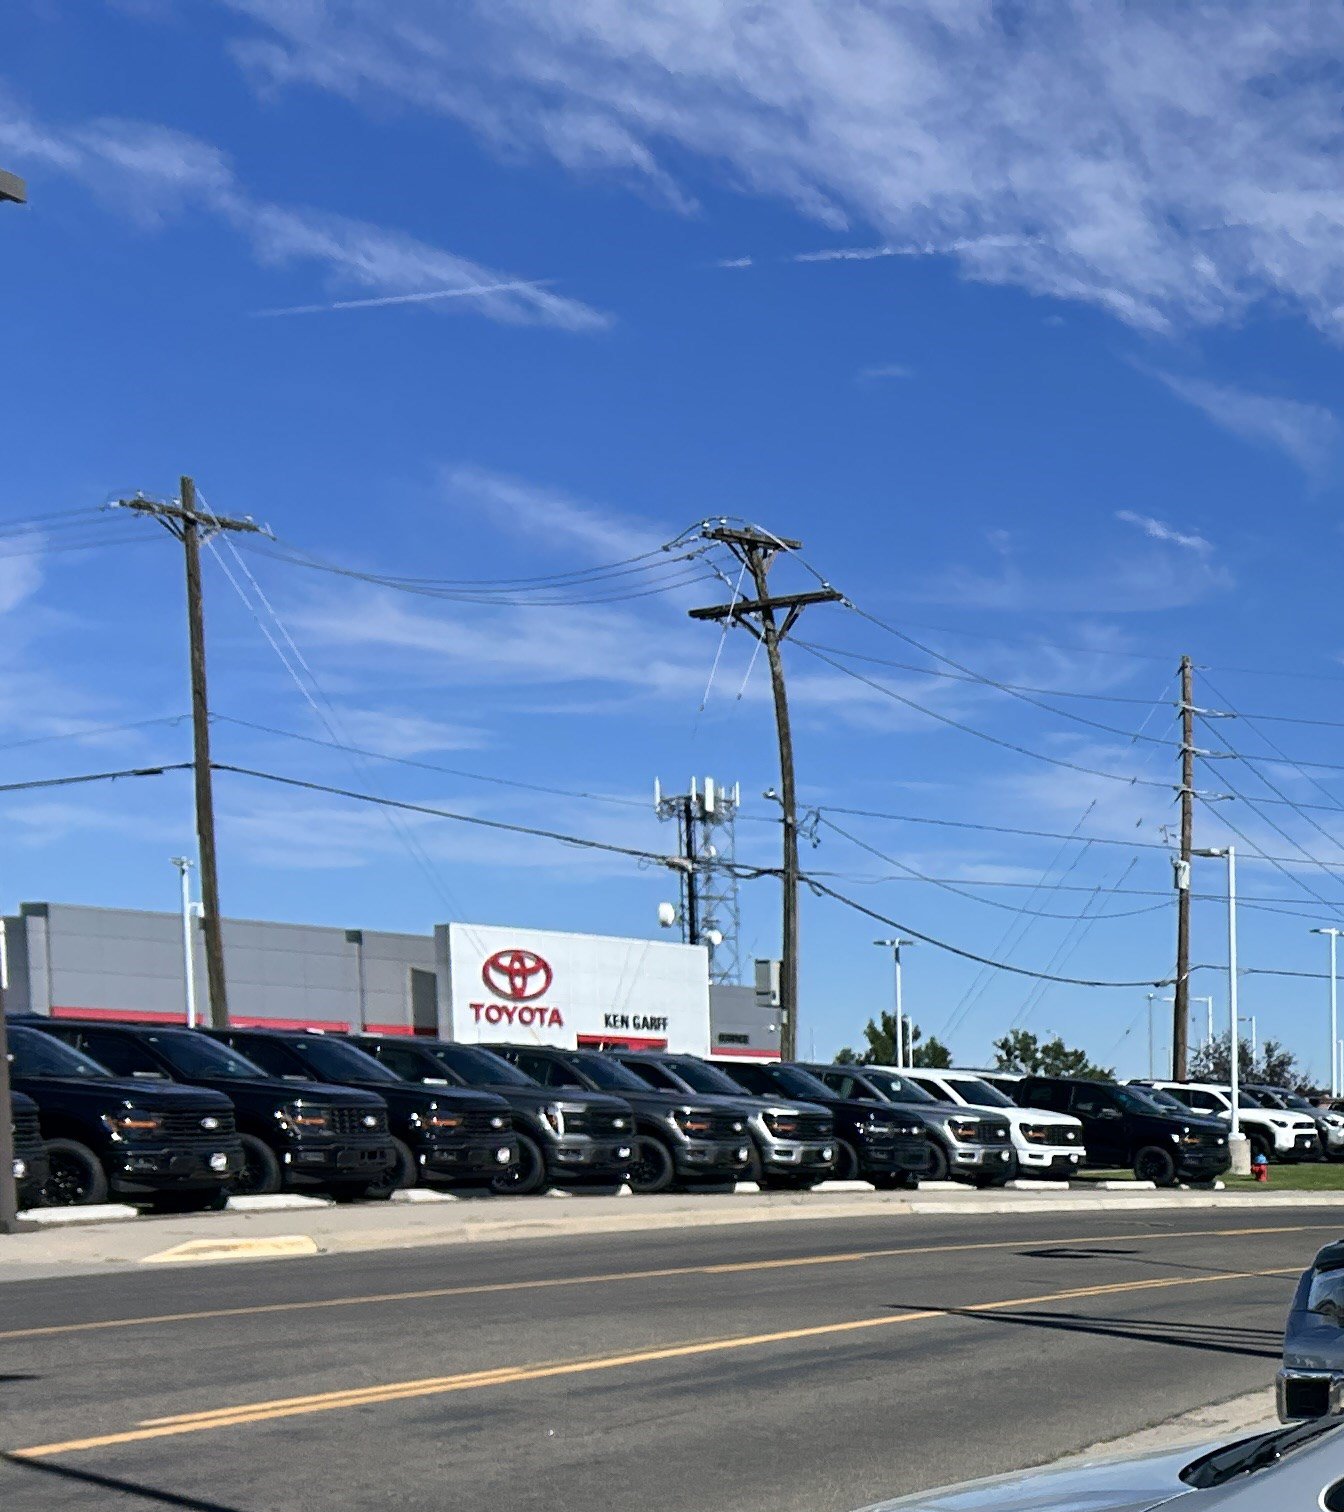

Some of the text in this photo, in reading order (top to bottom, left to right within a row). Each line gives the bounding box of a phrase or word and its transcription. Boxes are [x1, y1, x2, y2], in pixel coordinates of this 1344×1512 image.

[469, 1003, 564, 1028] TOYOTA
[604, 1012, 668, 1032] KEN GARFF
